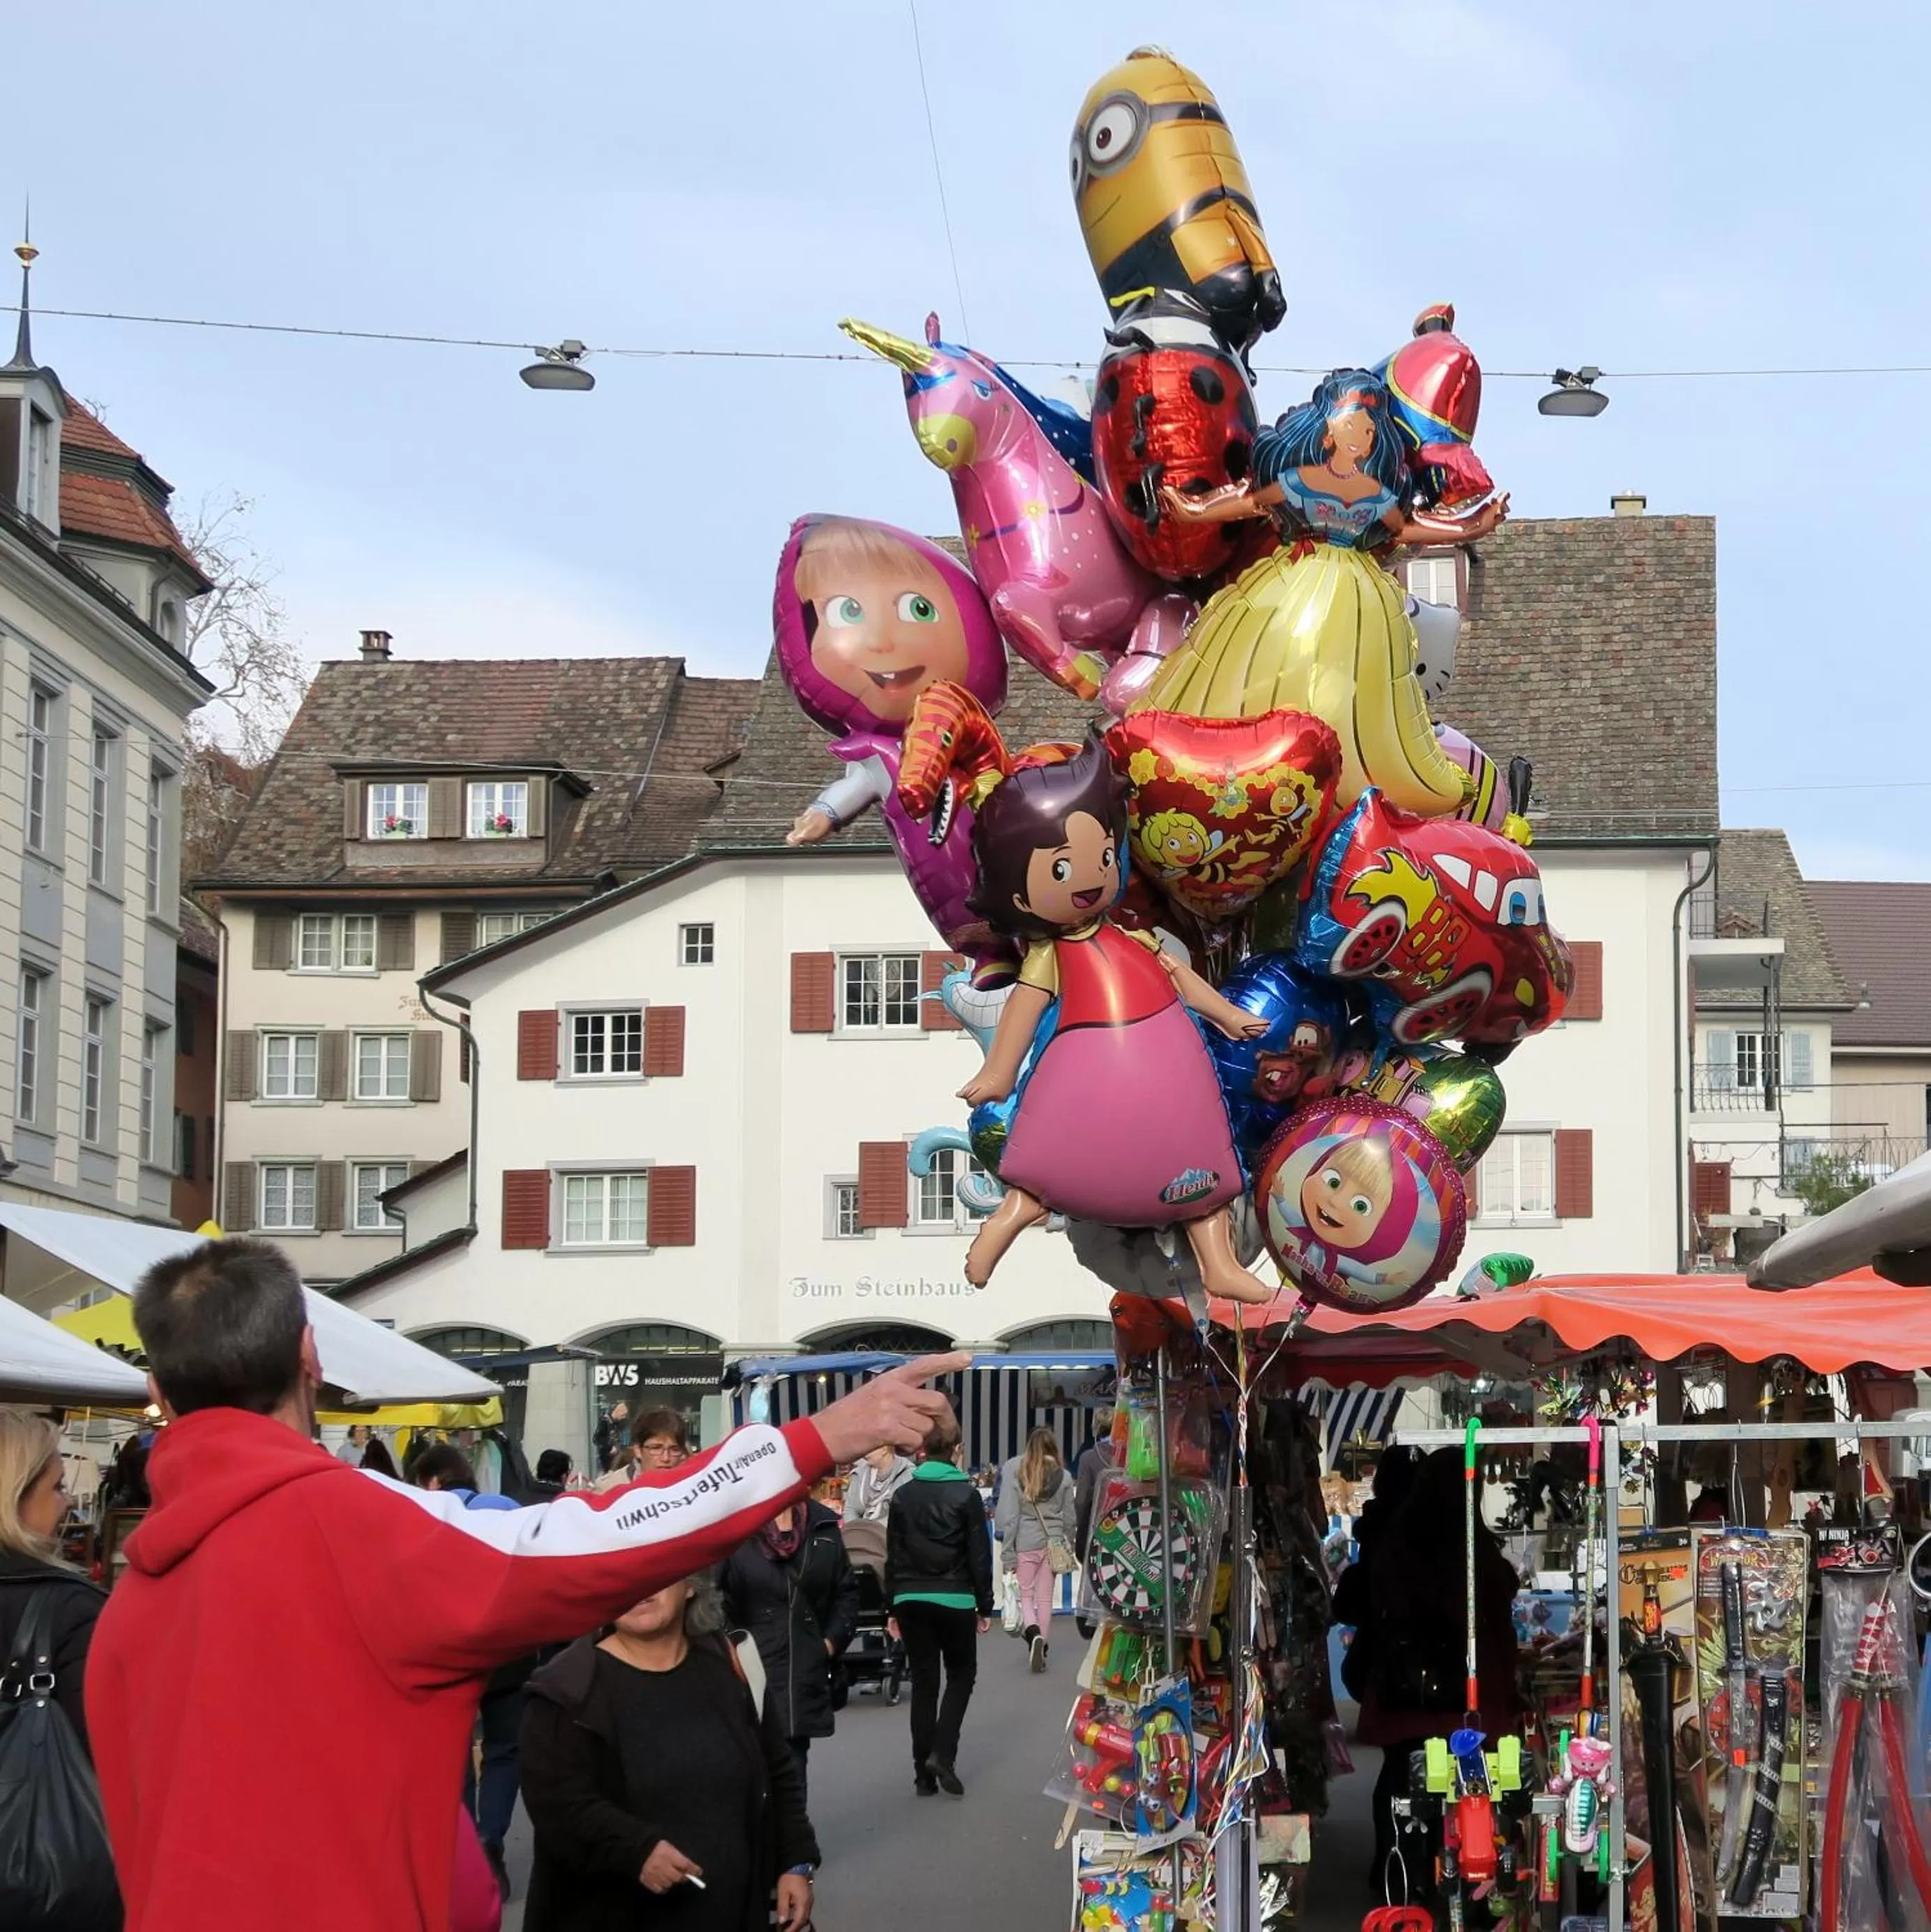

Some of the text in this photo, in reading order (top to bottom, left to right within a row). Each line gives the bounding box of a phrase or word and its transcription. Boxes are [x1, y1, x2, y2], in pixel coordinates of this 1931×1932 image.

[1165, 1169, 1216, 1203] Heidi
[789, 1276, 976, 1298] Zum Steinhaus
[594, 1364, 639, 1386] BWS
[616, 1461, 743, 1531] Tufertschwil
